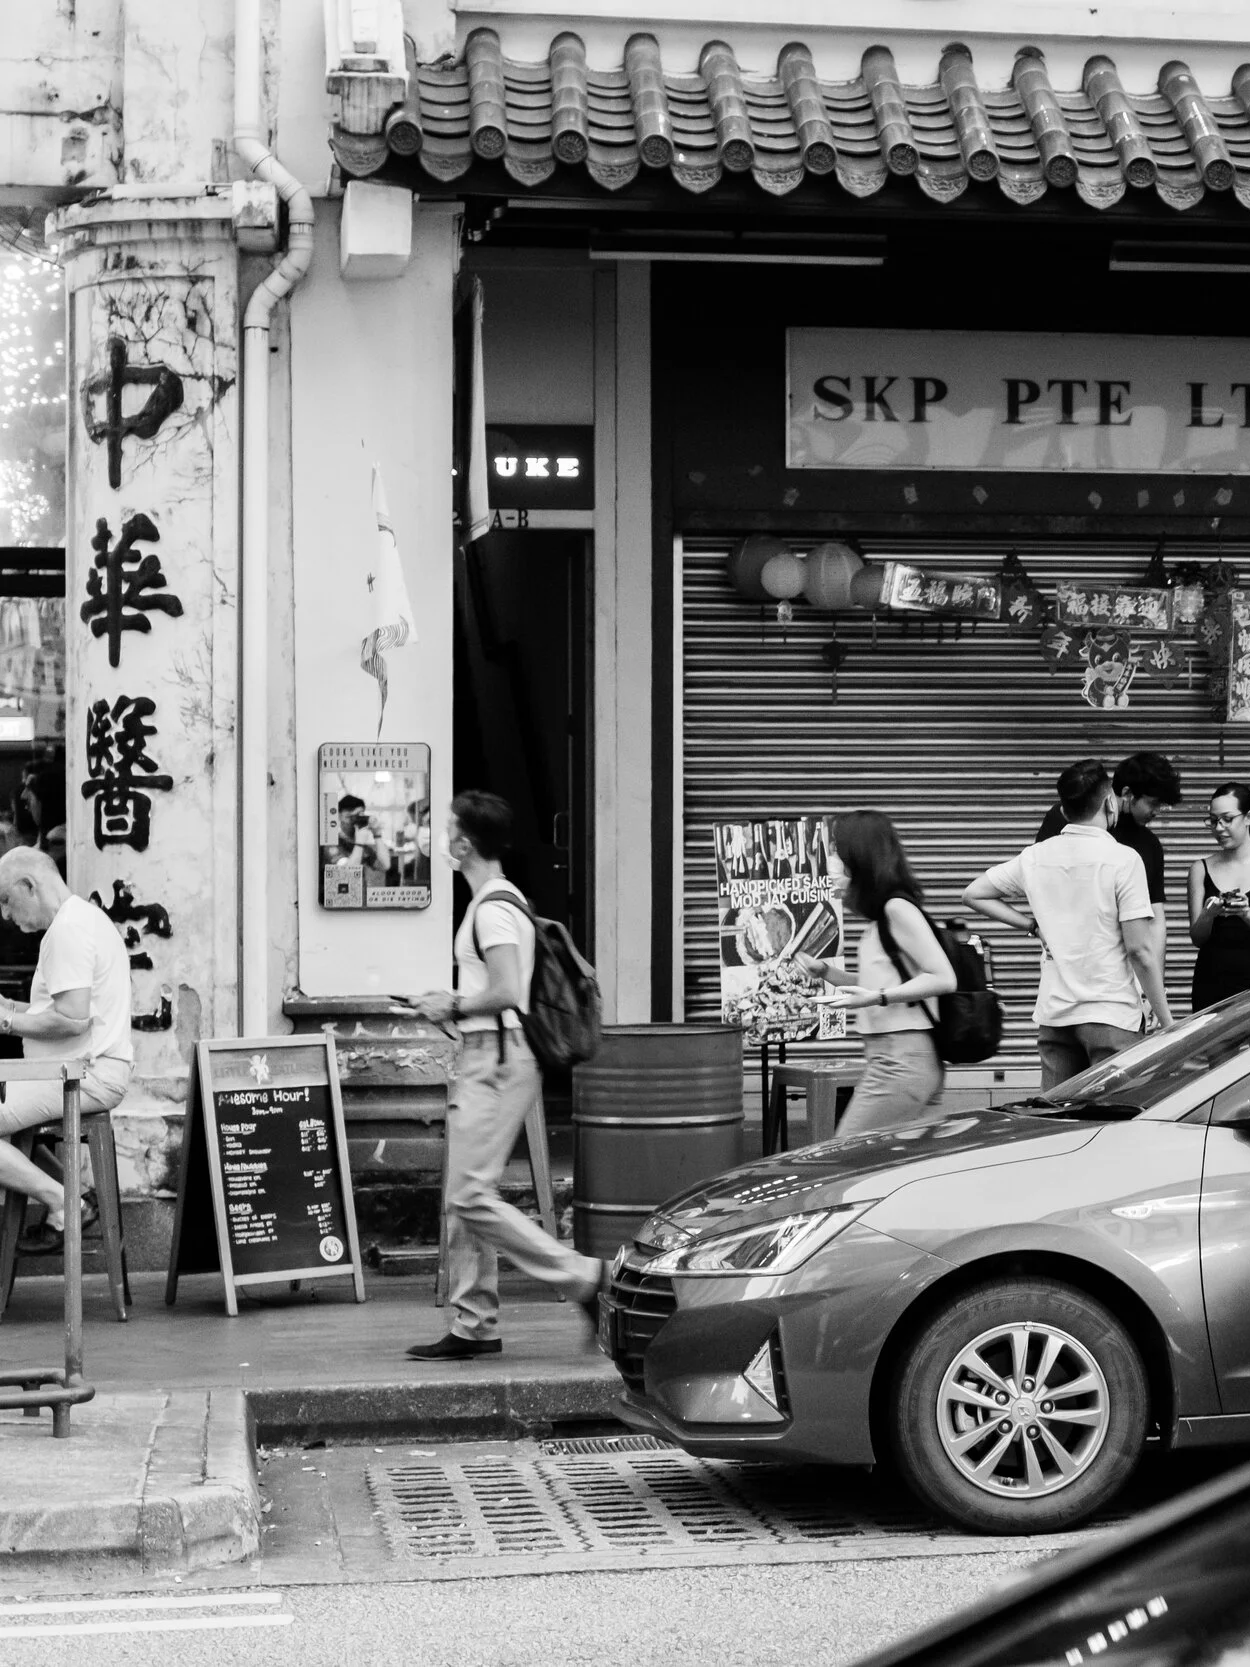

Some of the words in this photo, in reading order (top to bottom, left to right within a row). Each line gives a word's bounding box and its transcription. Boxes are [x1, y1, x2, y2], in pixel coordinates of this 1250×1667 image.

[812, 374, 950, 424] SKP
[1001, 377, 1134, 427] PTE
[452, 456, 580, 477] UKE
[323, 747, 354, 757] LOOKS
[361, 747, 382, 757] LIKE
[391, 747, 408, 757] YOU
[323, 760, 347, 769] NEED
[366, 760, 409, 769] HAIRCUT
[720, 877, 800, 896] HANDPICKED
[802, 875, 833, 890] SAKE
[730, 893, 762, 909] MOD
[764, 891, 788, 906] JAP
[790, 888, 836, 904] CUISINE
[272, 1087, 311, 1103] Hour!
